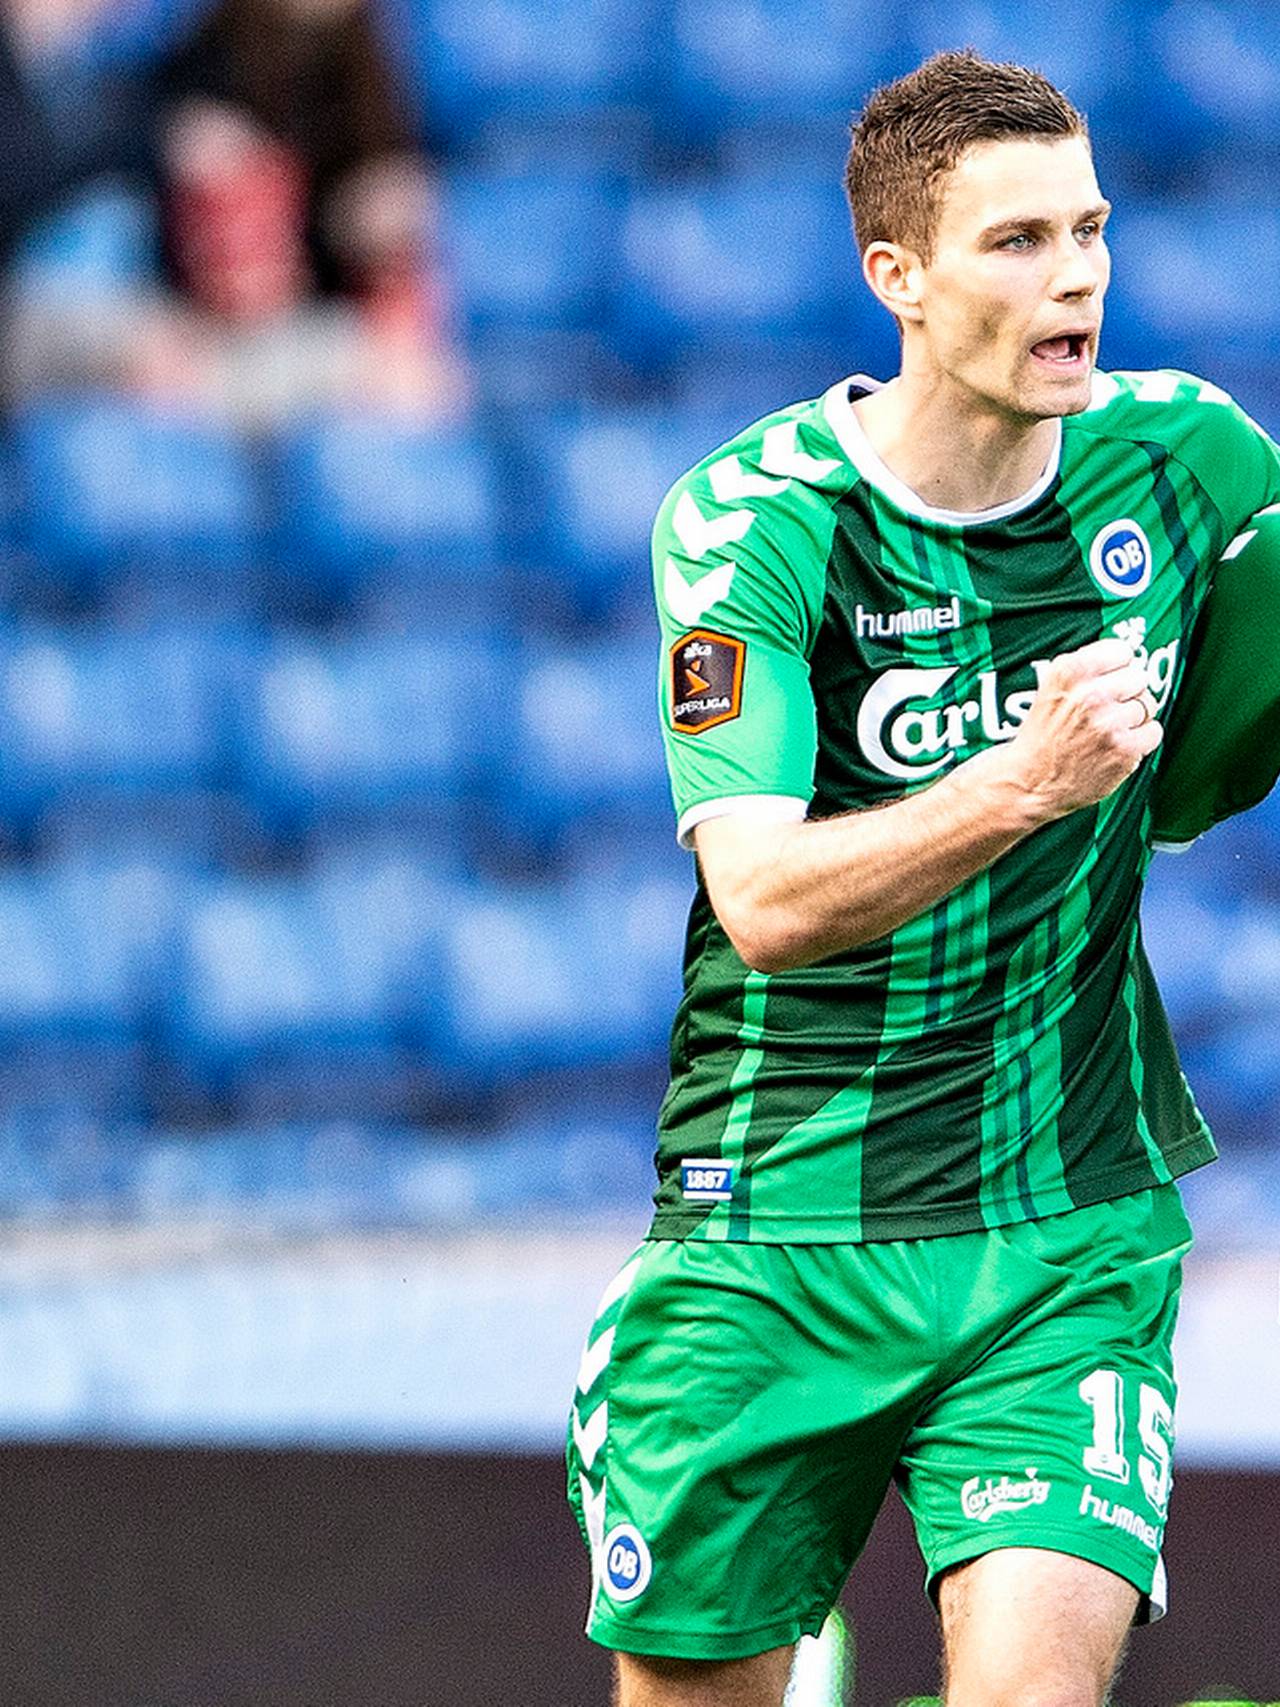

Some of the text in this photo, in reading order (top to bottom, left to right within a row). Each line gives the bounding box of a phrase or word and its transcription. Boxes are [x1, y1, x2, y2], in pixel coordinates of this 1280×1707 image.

[1105, 538, 1144, 575] OB
[856, 598, 960, 638] hummel
[686, 1170, 728, 1189] 1887
[1079, 1369, 1175, 1517] 15
[961, 1475, 1051, 1520] Carlsberg
[609, 1544, 638, 1580] OB
